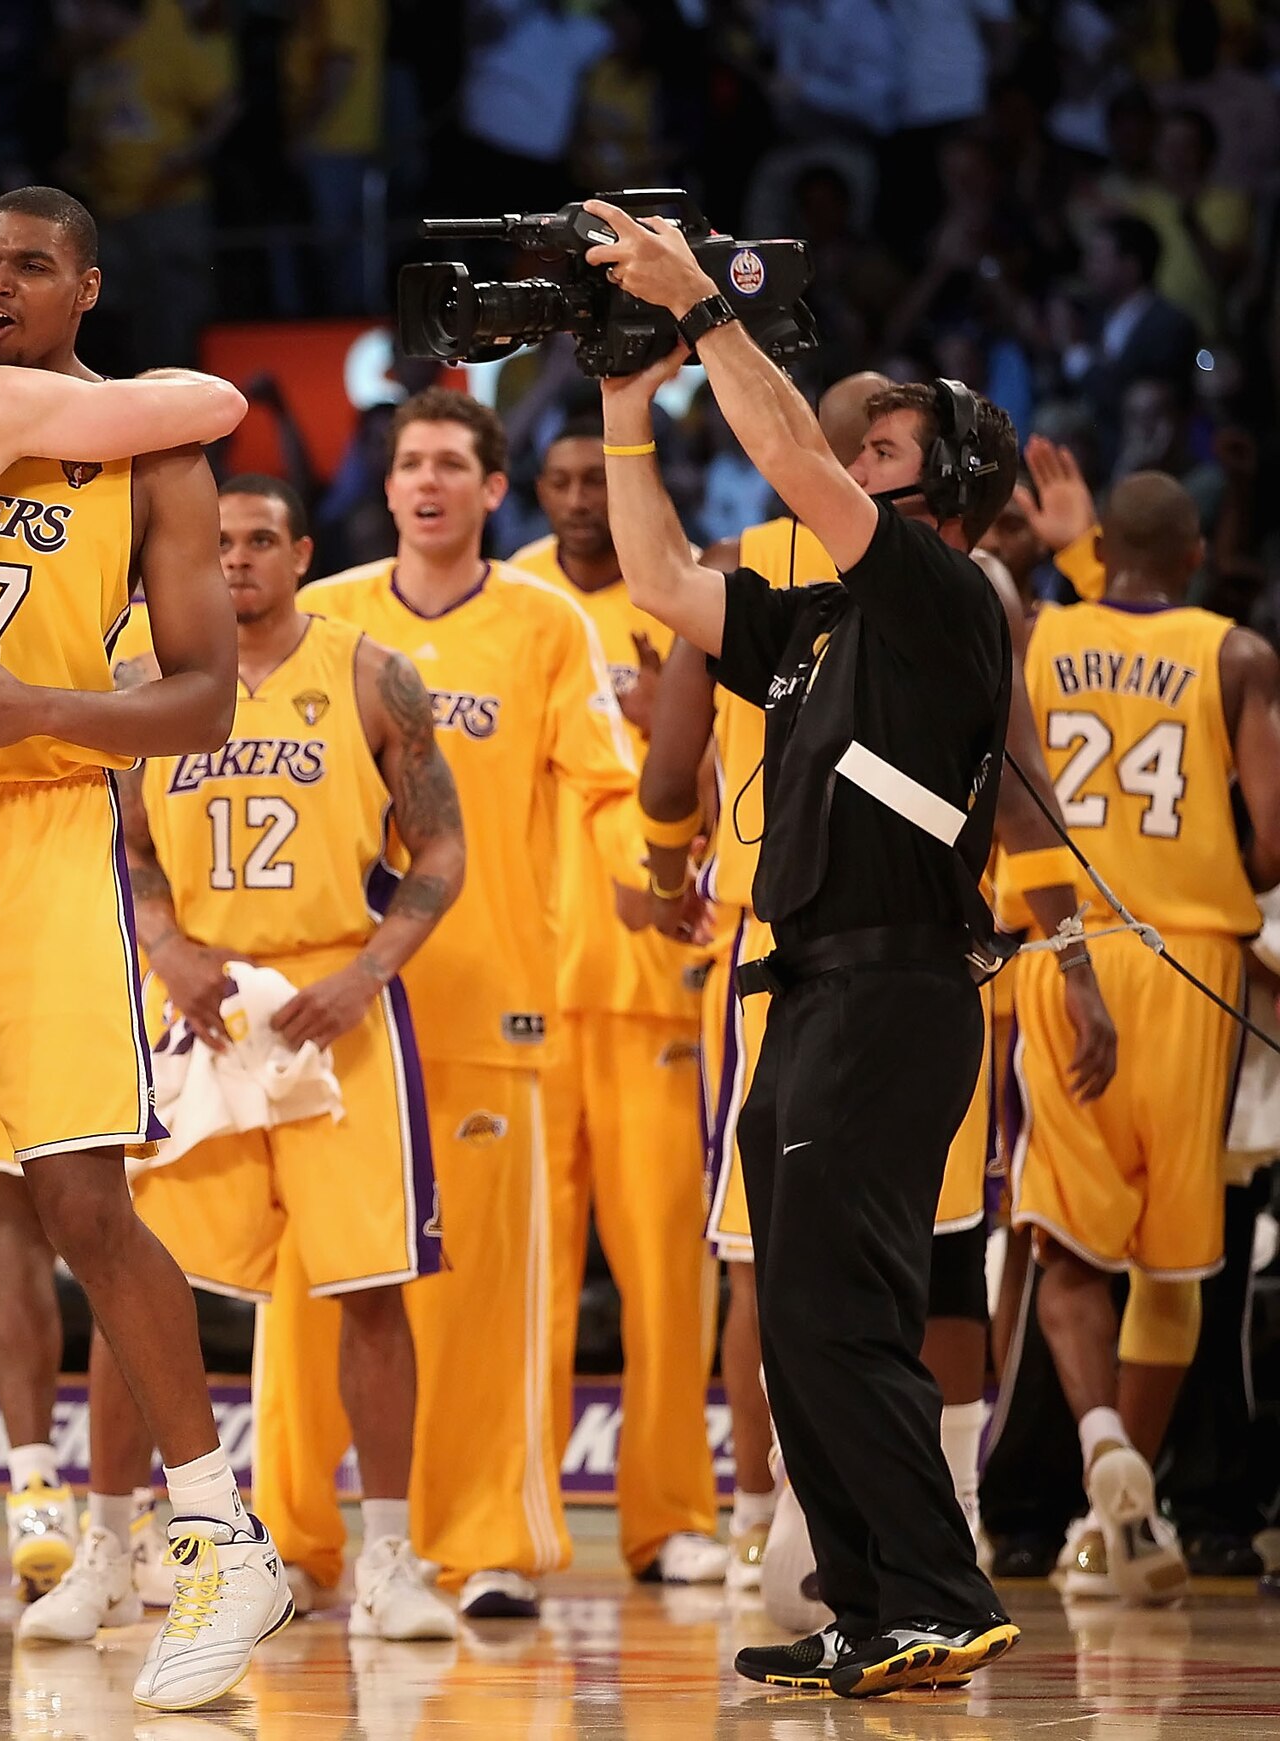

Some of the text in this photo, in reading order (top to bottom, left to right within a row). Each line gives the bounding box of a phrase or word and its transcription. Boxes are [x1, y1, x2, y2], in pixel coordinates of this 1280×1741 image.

[1054, 651, 1199, 709] BRYANT
[167, 736, 326, 795] LAKERS
[1046, 710, 1188, 839] 24
[206, 796, 299, 890] 12
